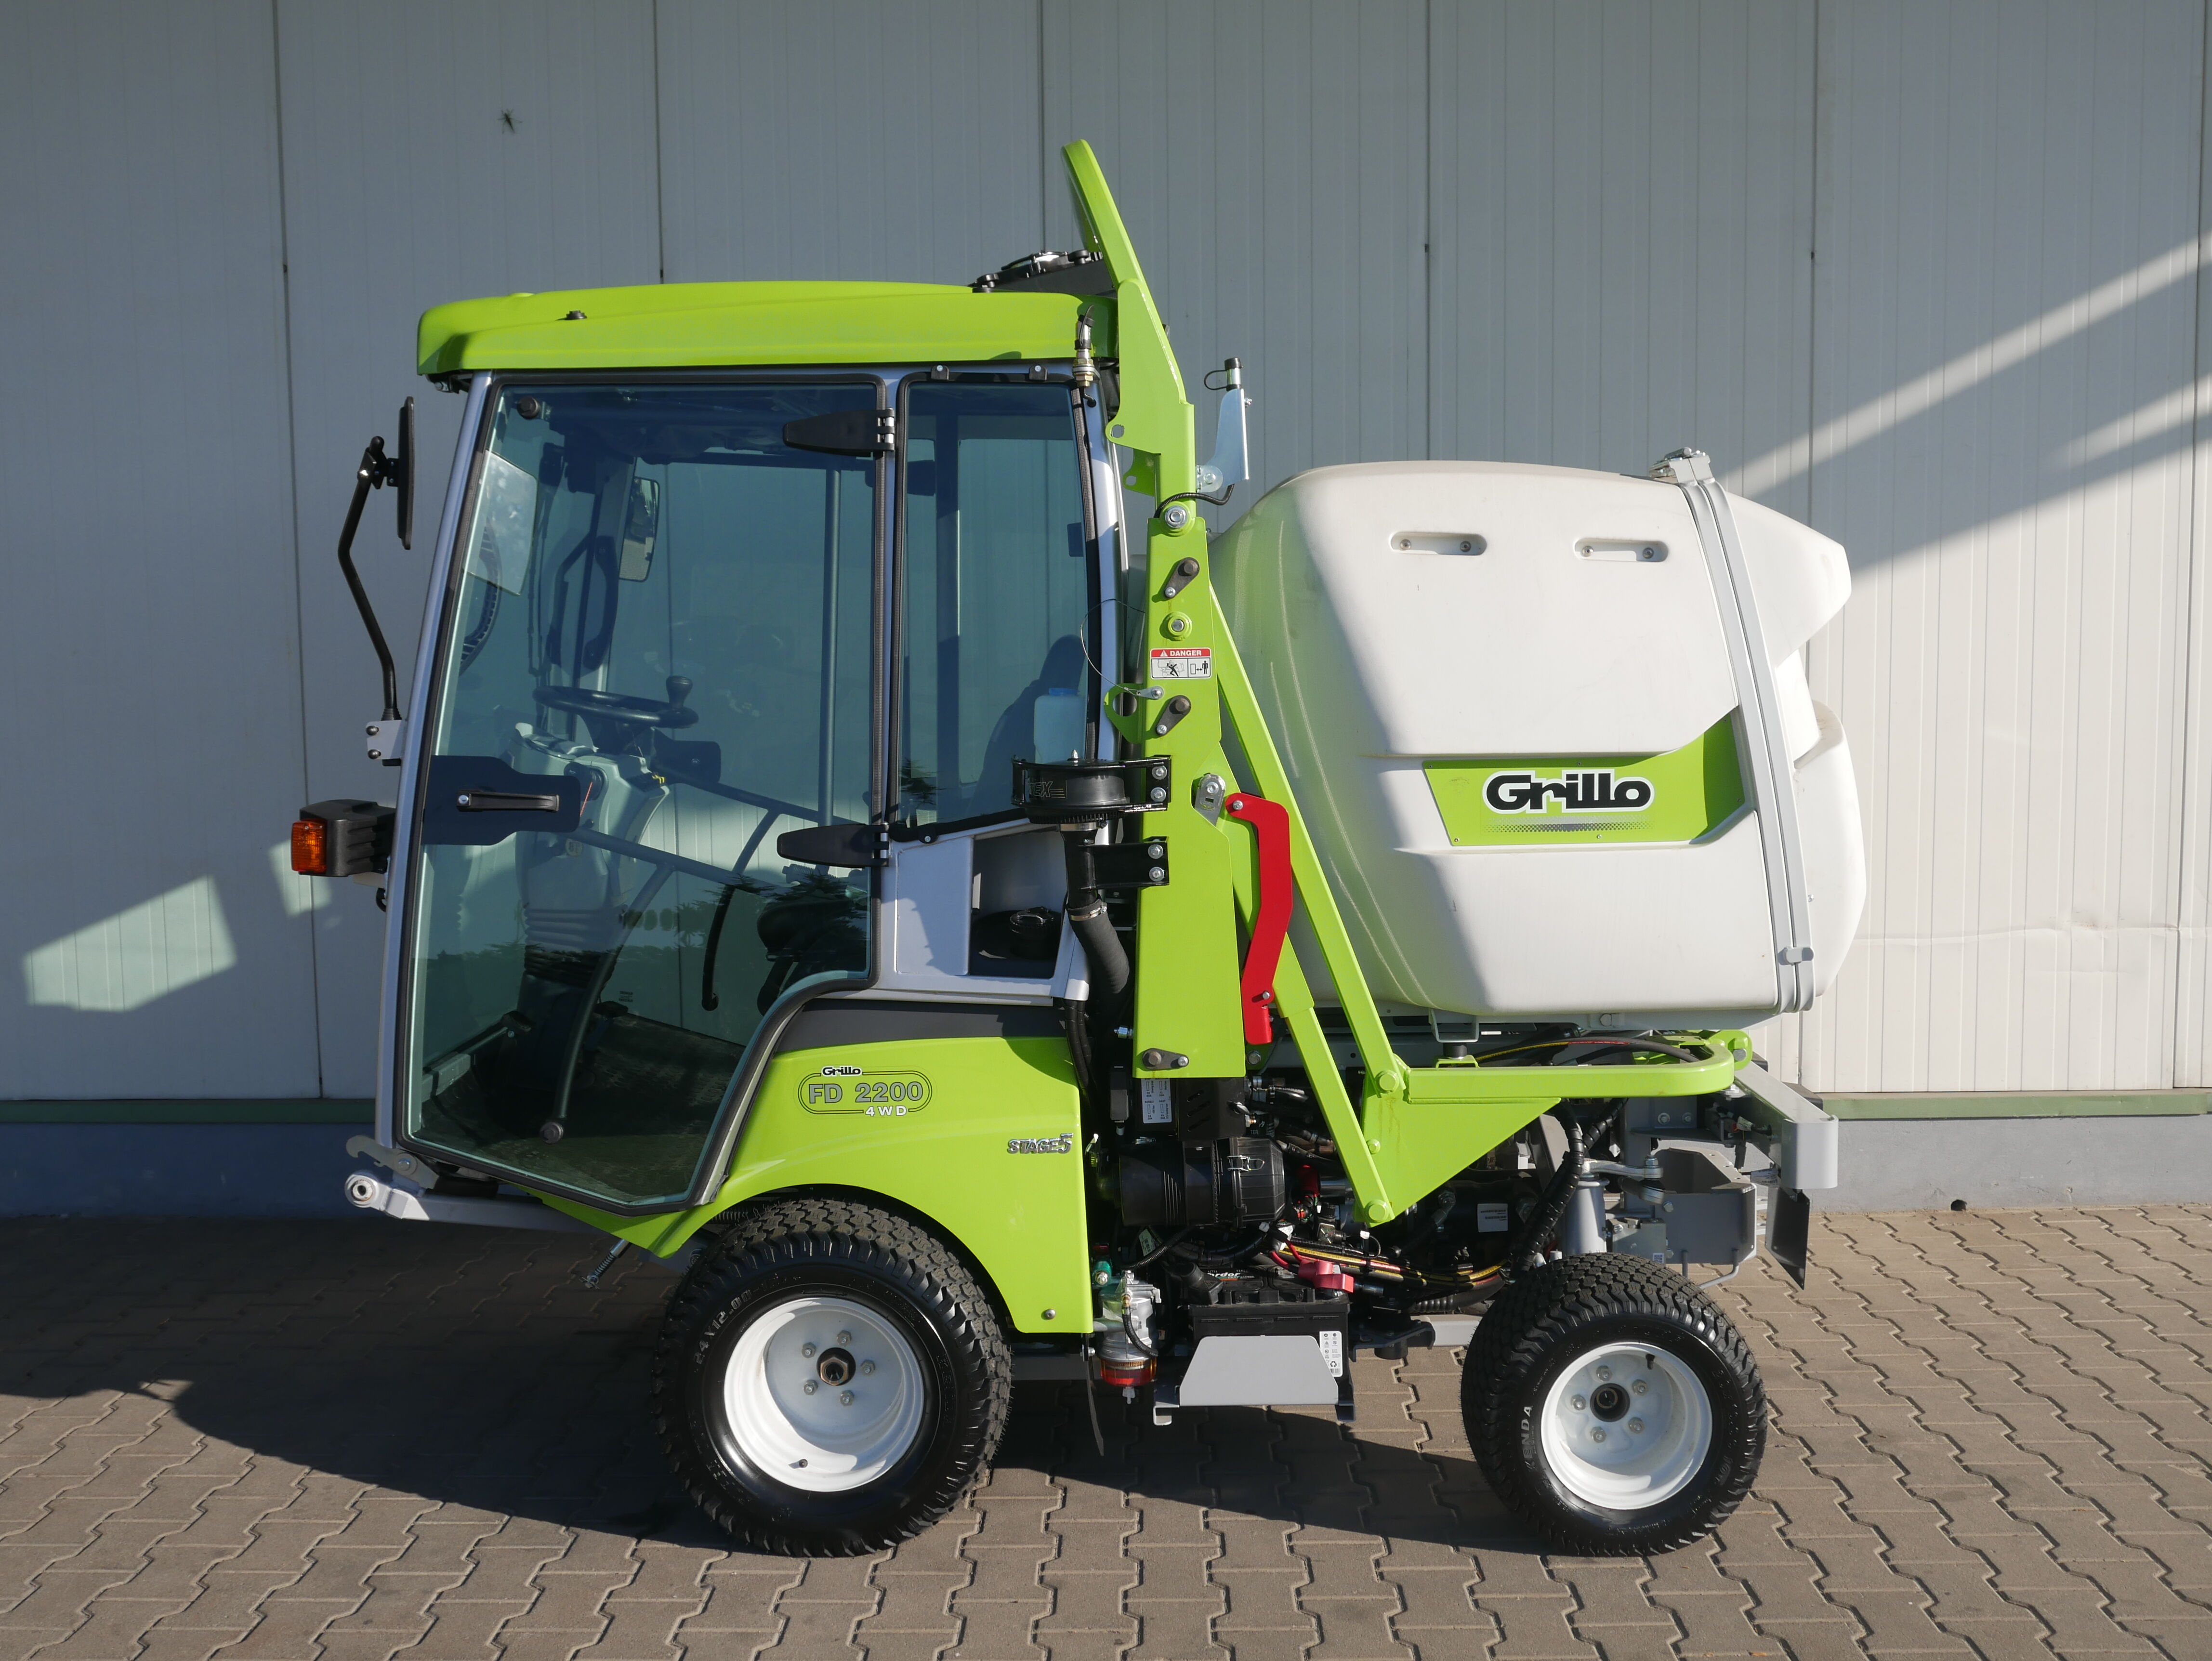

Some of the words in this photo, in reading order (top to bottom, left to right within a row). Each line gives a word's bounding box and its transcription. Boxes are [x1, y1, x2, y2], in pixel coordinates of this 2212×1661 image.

[1486, 772, 1651, 811] Grillo
[822, 1066, 861, 1077] Grillo
[808, 1083, 843, 1104] FD
[855, 1081, 924, 1103] 2200
[865, 1105, 907, 1117] 4WD
[1521, 1405, 1538, 1472] KENDA
